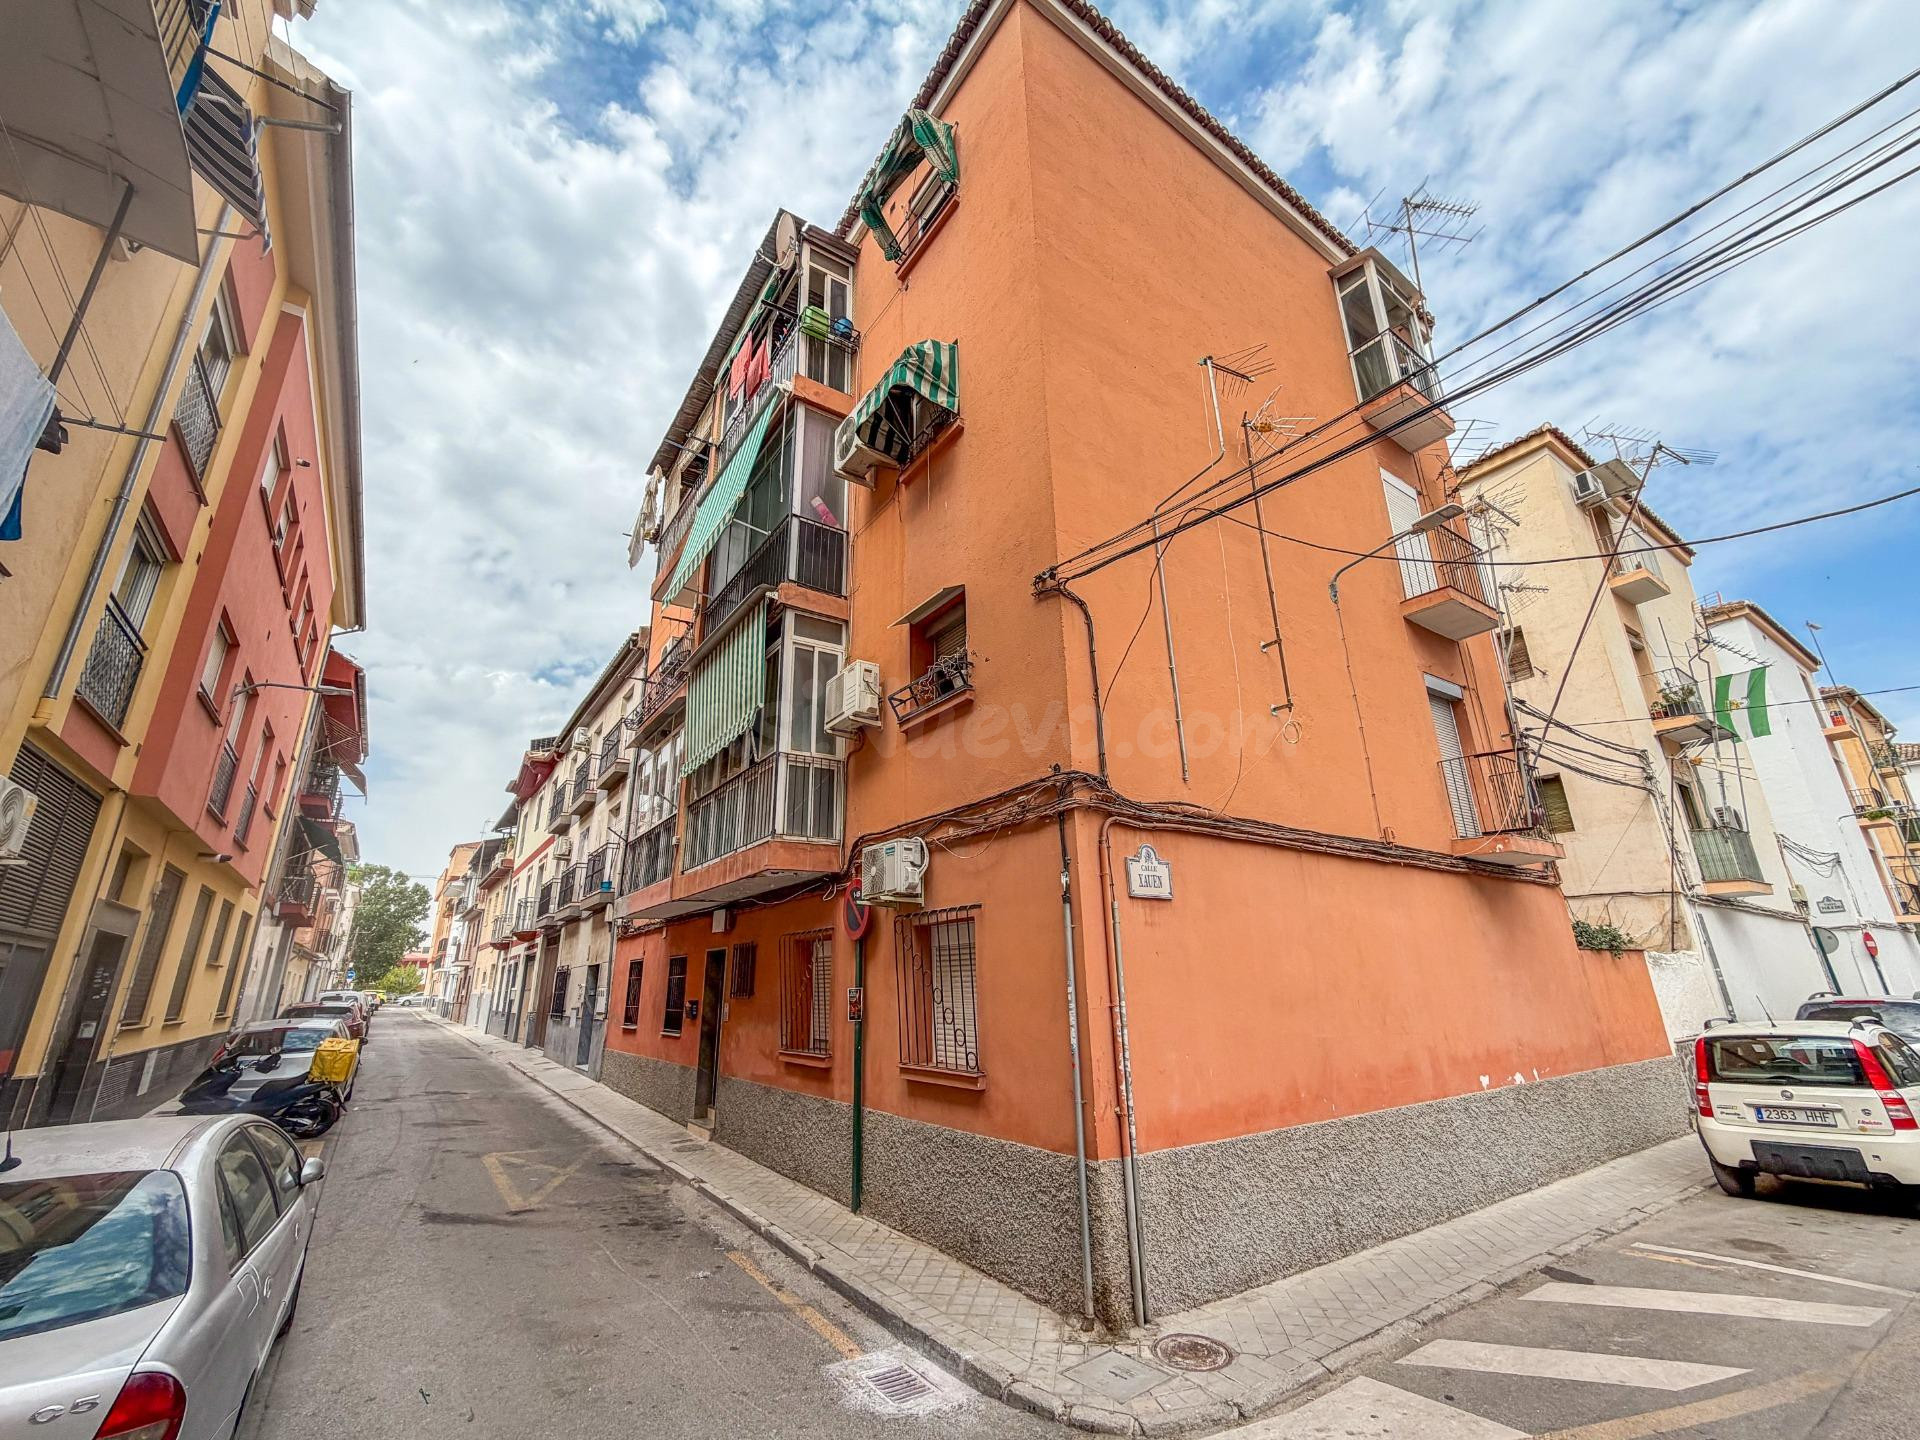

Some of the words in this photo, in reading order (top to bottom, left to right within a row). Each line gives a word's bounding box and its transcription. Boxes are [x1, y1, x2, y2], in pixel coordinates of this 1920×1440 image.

[1138, 873, 1163, 889] XAUEN
[1765, 1108, 1797, 1121] 2363
[1805, 1110, 1831, 1123] HHF
[29, 1393, 101, 1425] C5
